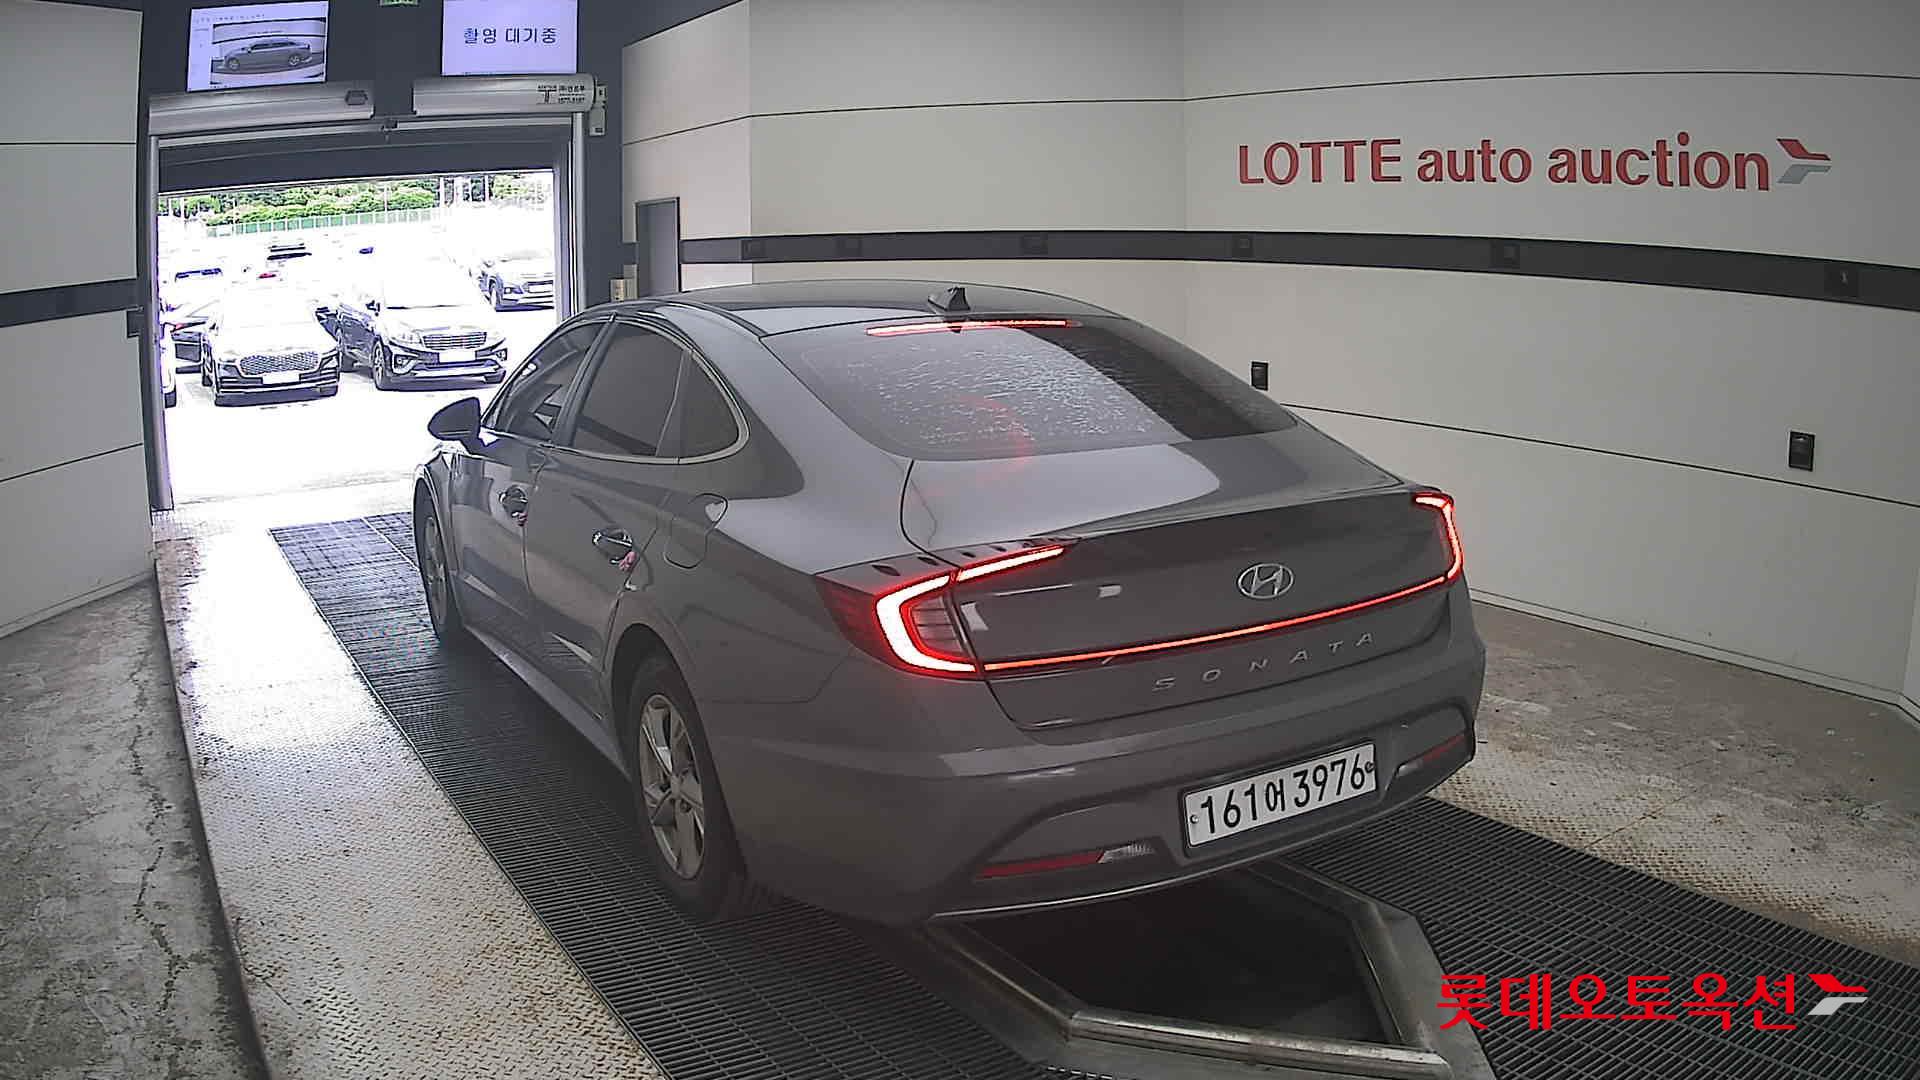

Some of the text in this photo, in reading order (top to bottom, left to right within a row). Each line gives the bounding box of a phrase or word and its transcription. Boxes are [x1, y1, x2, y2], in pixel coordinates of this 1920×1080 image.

[504, 27, 557, 44] 대기중
[1238, 131, 1770, 192] LOTTE auto auction
[1151, 632, 1374, 691] SONATA
